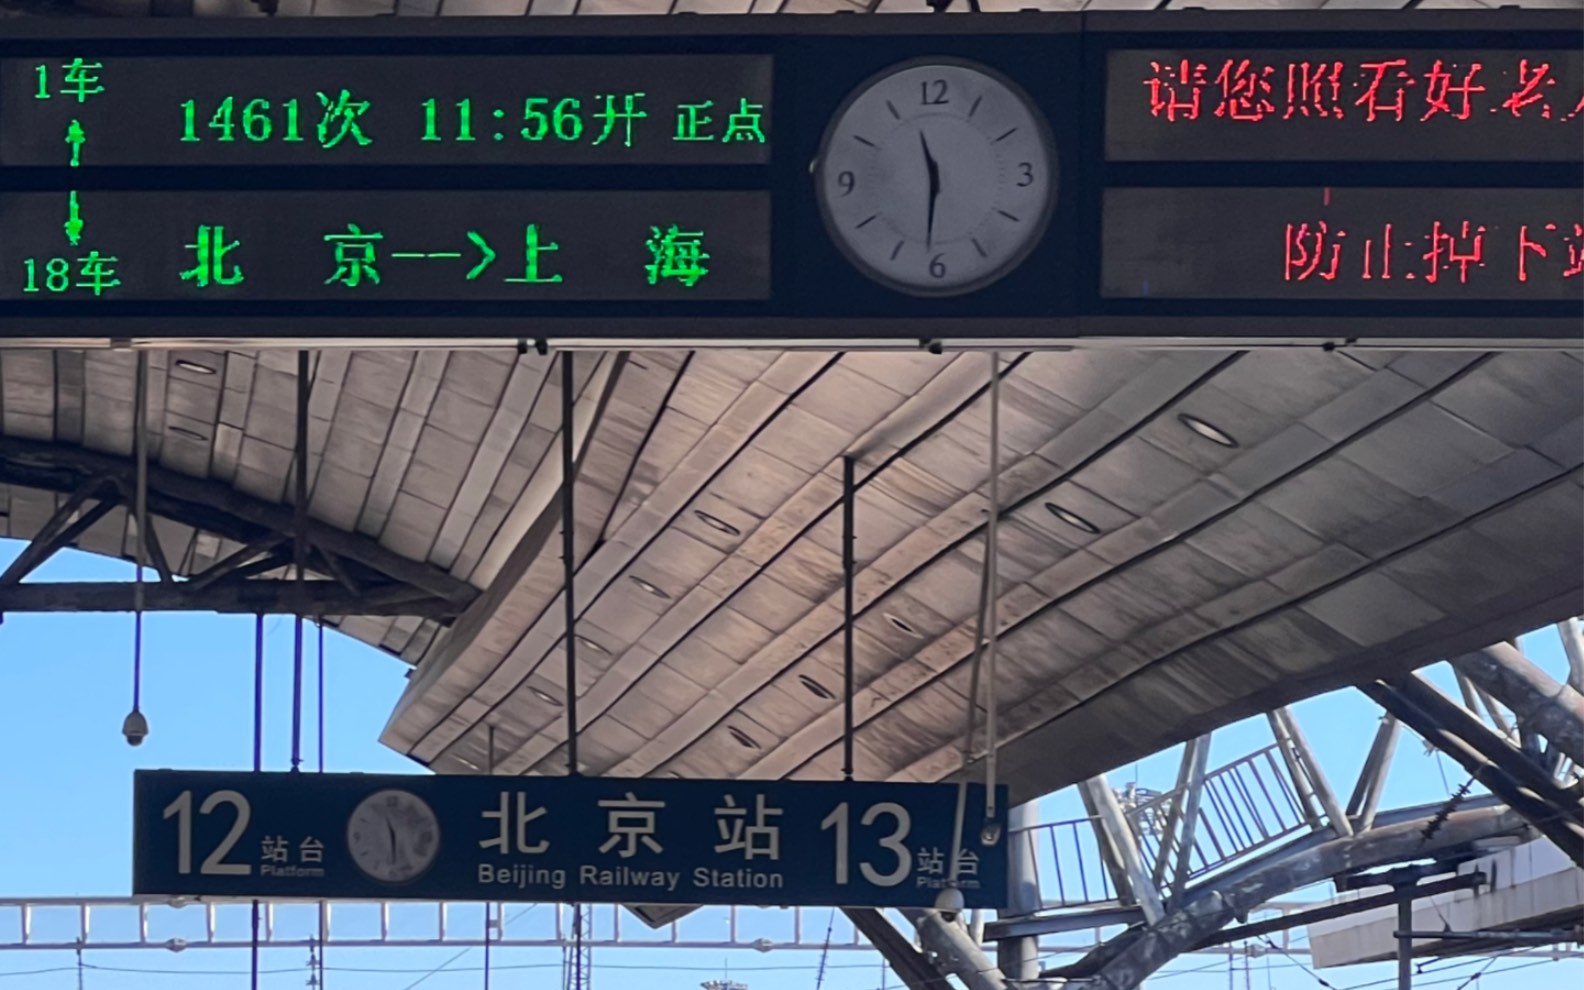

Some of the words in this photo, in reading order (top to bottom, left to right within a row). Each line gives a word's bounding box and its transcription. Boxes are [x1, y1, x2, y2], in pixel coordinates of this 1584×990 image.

[34, 57, 106, 103] 1车
[920, 79, 949, 105] 12
[180, 89, 373, 149] 1461次
[421, 92, 649, 148] 11:56开
[673, 97, 766, 143] 正点
[837, 170, 856, 197] 9
[1016, 161, 1034, 187] 3
[23, 250, 121, 296] 18车
[929, 253, 946, 278] 6
[163, 789, 252, 875] 12
[478, 791, 784, 860] 北京站
[260, 835, 324, 863] 站台
[820, 801, 912, 887] 13
[260, 864, 325, 877] Platform
[917, 847, 980, 876] 站台
[478, 863, 566, 889] Beijing
[579, 865, 680, 891] Railway
[692, 867, 784, 889] Station
